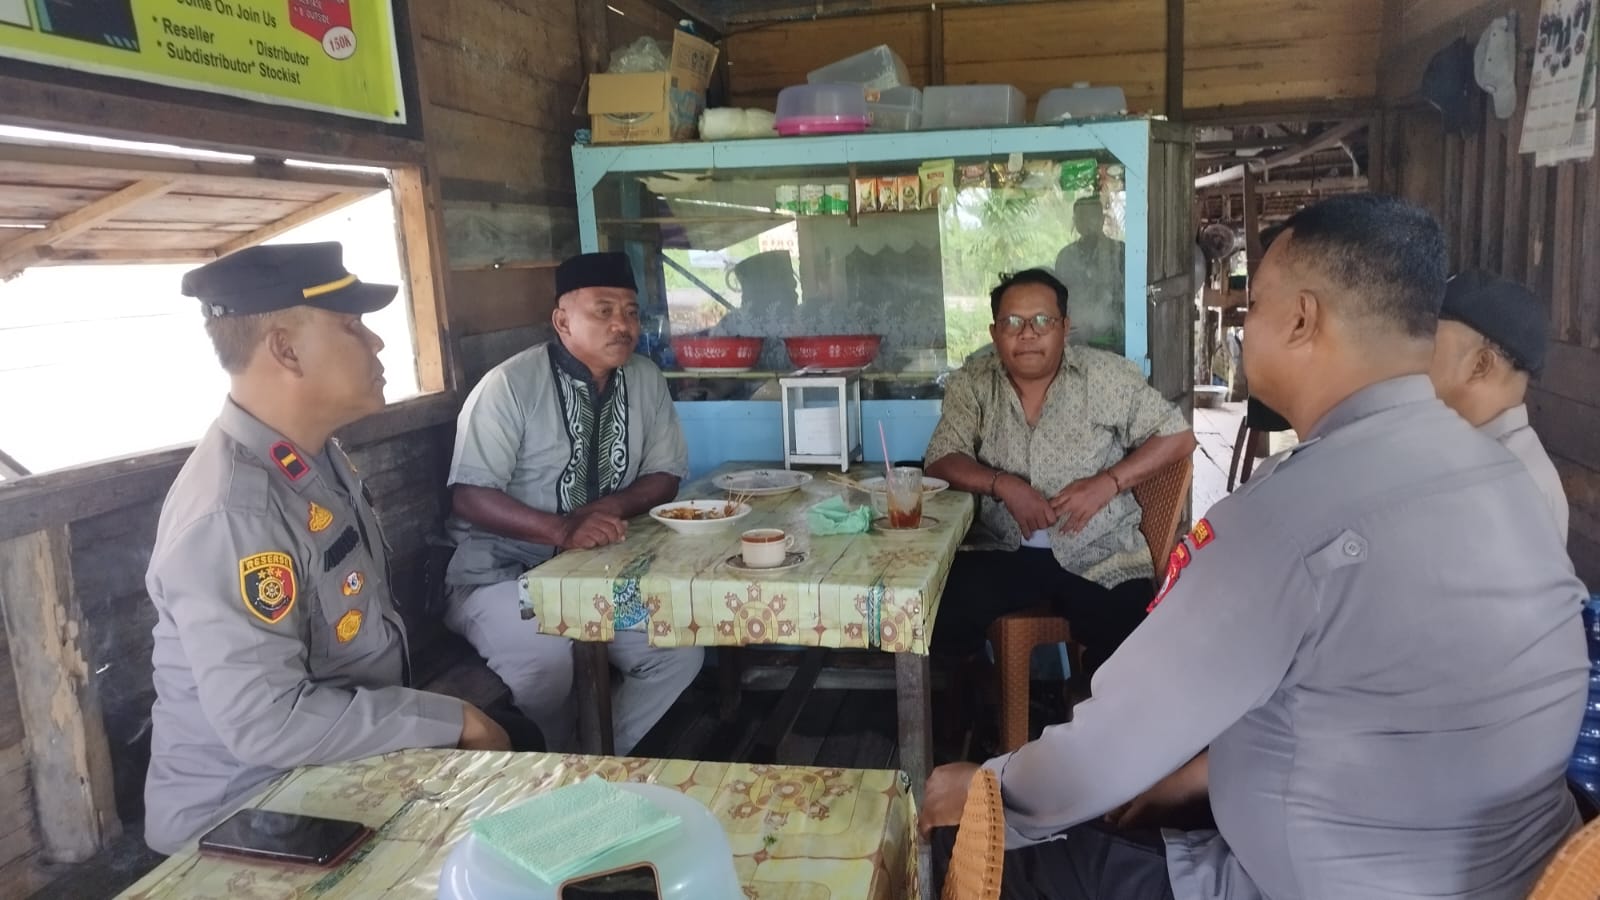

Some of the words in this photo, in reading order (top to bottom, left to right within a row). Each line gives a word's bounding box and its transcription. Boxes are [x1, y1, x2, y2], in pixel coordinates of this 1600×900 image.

[215, 0, 234, 17] On
[236, 4, 261, 24] Join
[262, 9, 277, 28] Us
[162, 17, 215, 44] Reseller
[167, 42, 251, 74] Subdistributor
[256, 40, 311, 66] Distributor
[259, 63, 302, 85] Stockist
